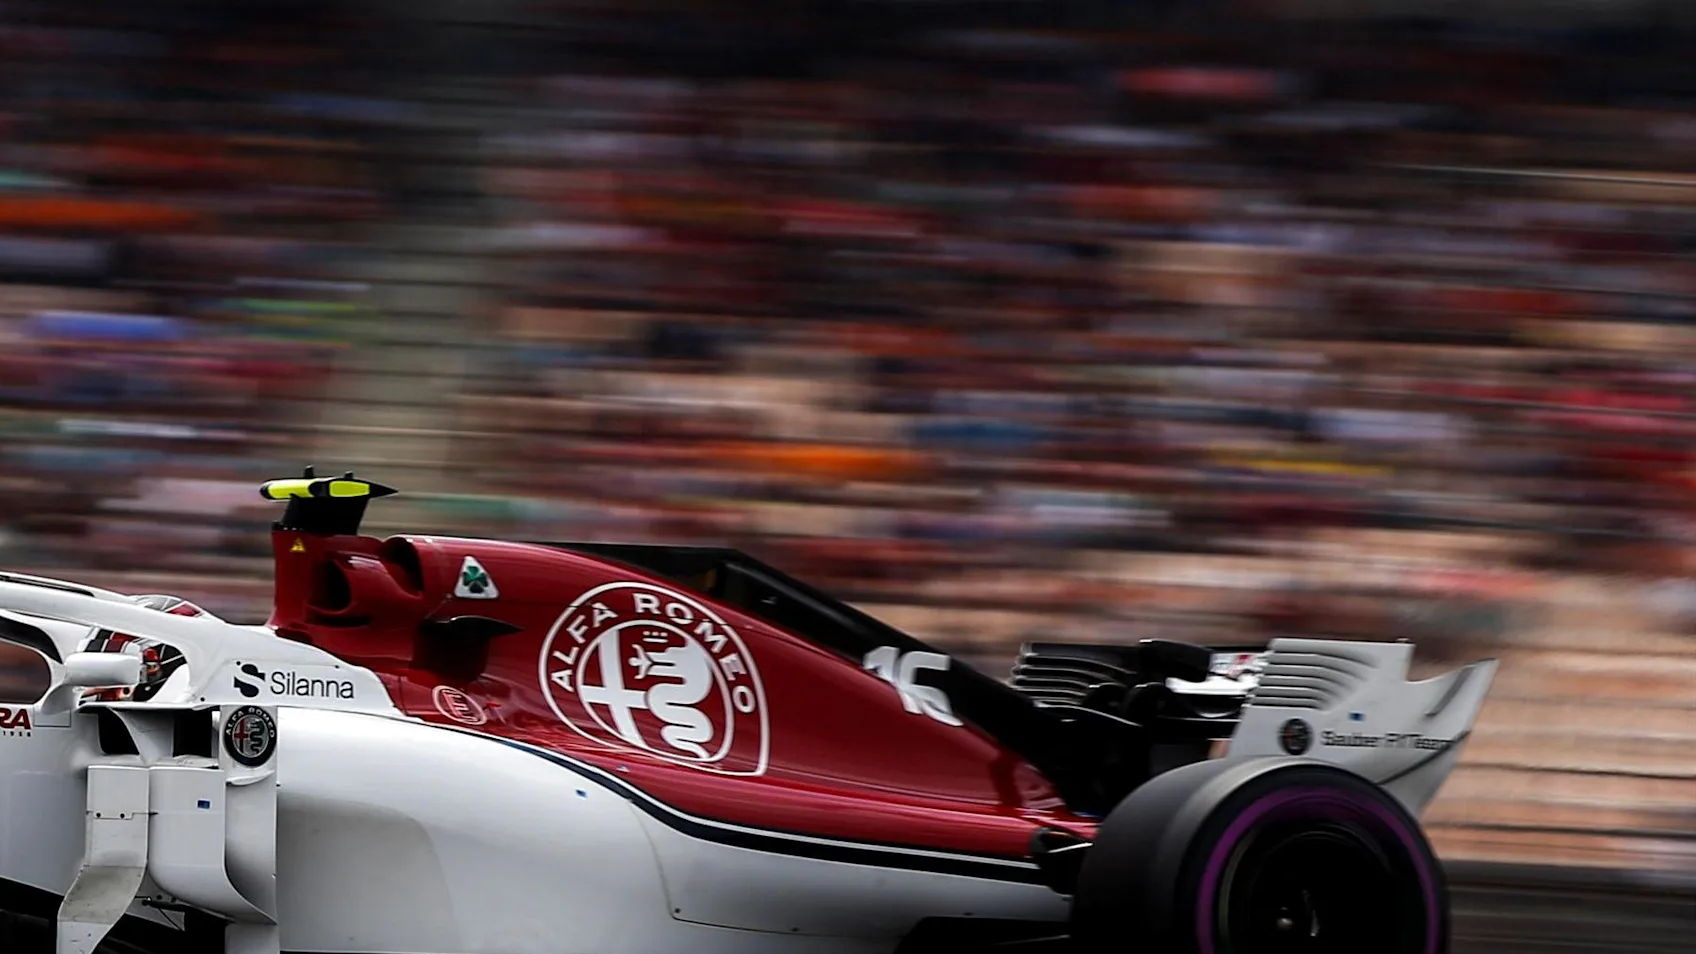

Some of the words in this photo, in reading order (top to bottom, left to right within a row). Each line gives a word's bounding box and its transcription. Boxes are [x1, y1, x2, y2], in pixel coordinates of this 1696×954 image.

[551, 602, 618, 693] ALFA
[632, 592, 756, 714] ROMEO
[270, 671, 354, 699] Silanna
[863, 645, 964, 727] 16
[225, 710, 244, 736] ALFA
[248, 706, 276, 738] ROMEO
